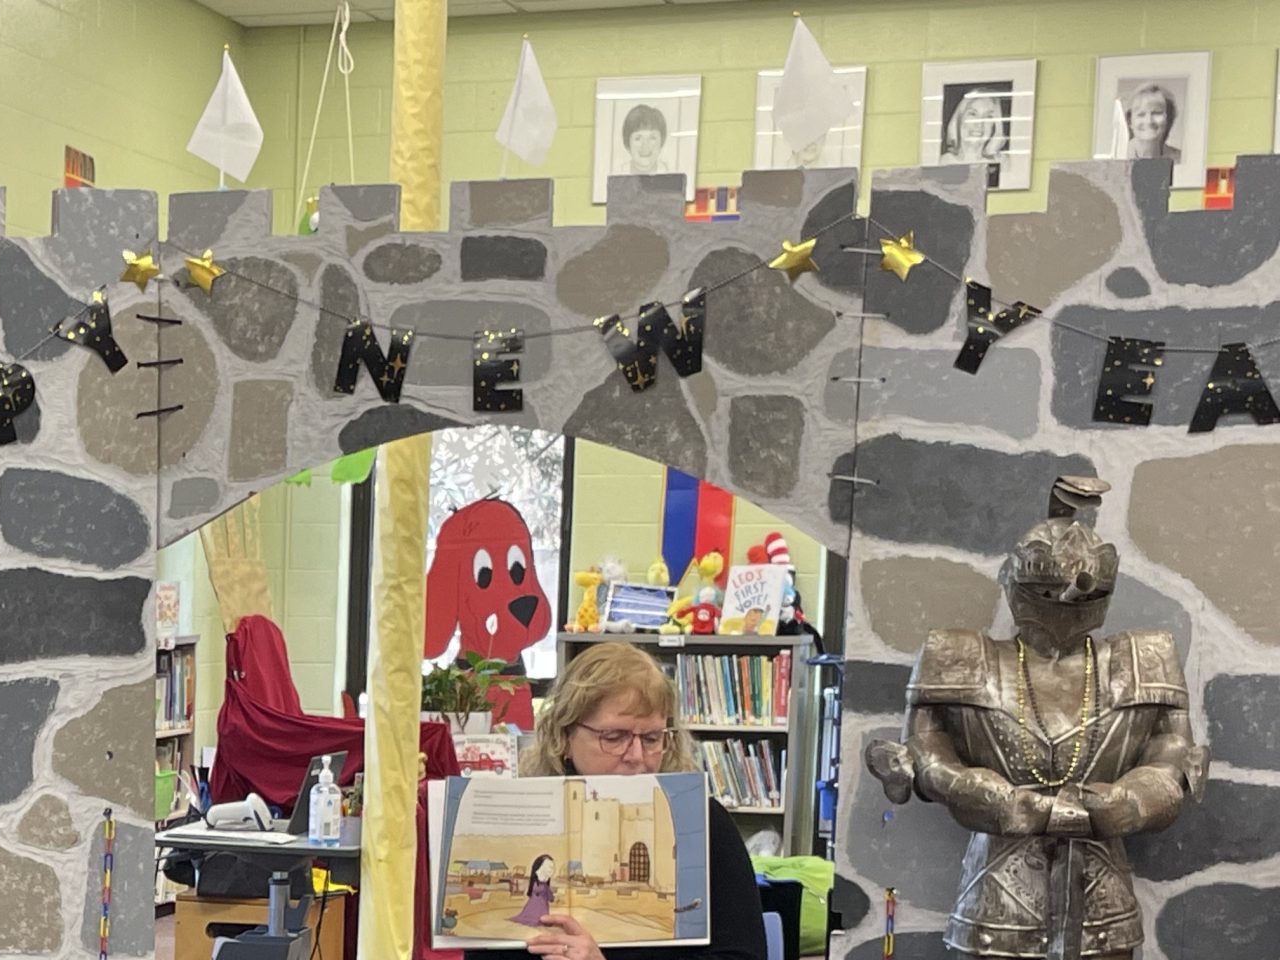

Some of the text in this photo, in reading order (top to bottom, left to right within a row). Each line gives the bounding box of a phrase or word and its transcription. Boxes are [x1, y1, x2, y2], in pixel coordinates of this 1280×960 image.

[333, 287, 706, 412] NEW
[953, 277, 1280, 433] YEA
[734, 581, 768, 602] FIRST
